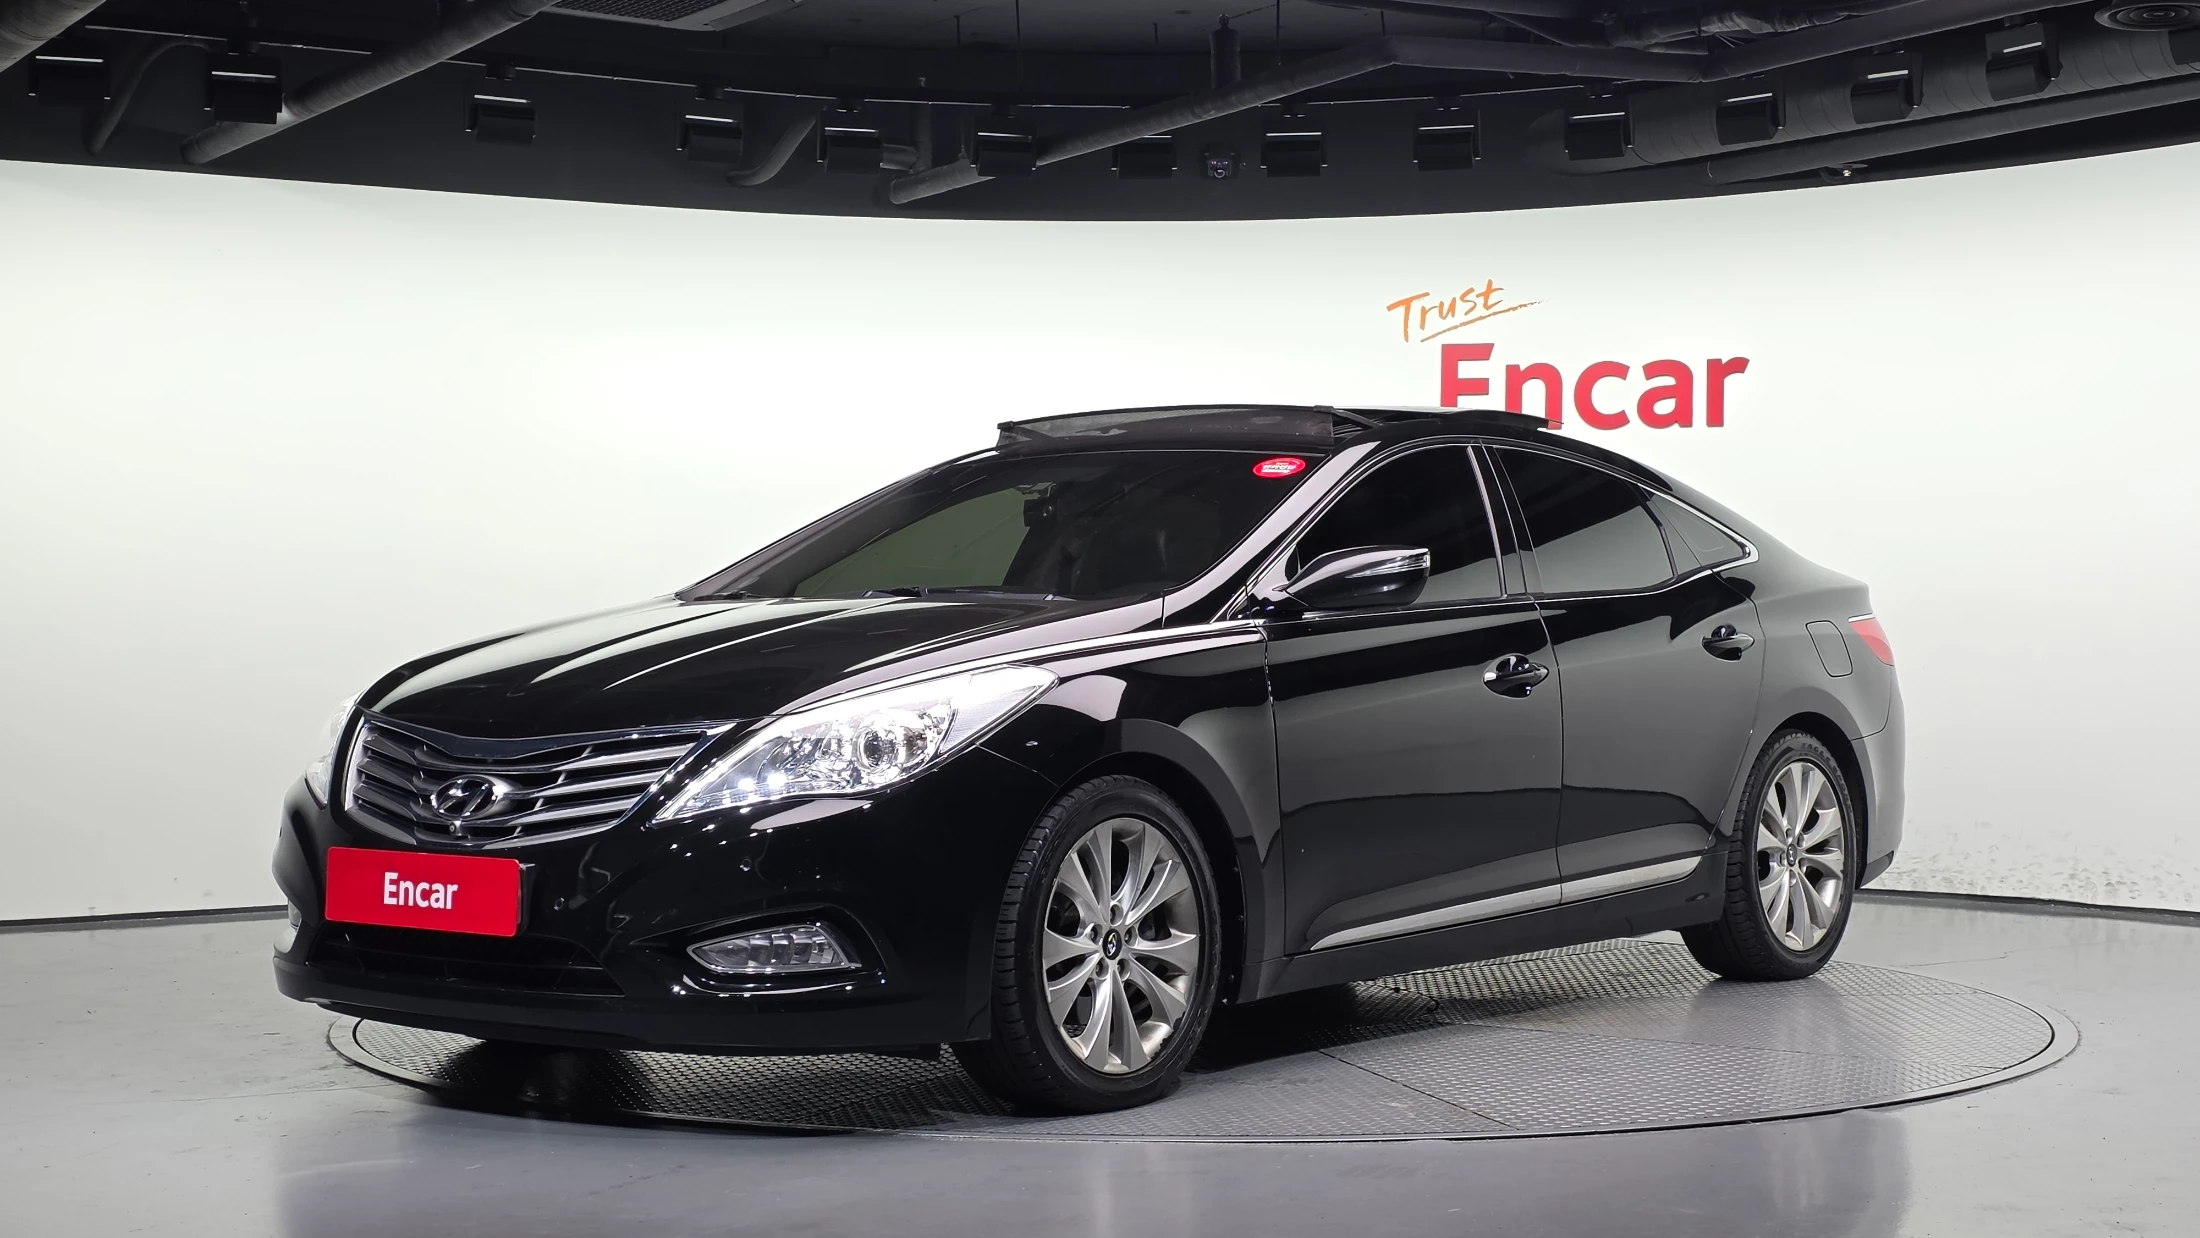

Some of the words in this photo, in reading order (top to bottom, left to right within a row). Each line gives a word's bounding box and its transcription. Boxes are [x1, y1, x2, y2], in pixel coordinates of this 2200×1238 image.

[1386, 279, 1505, 343] Trust
[1440, 343, 1750, 431] Encar
[383, 871, 459, 910] Encar
